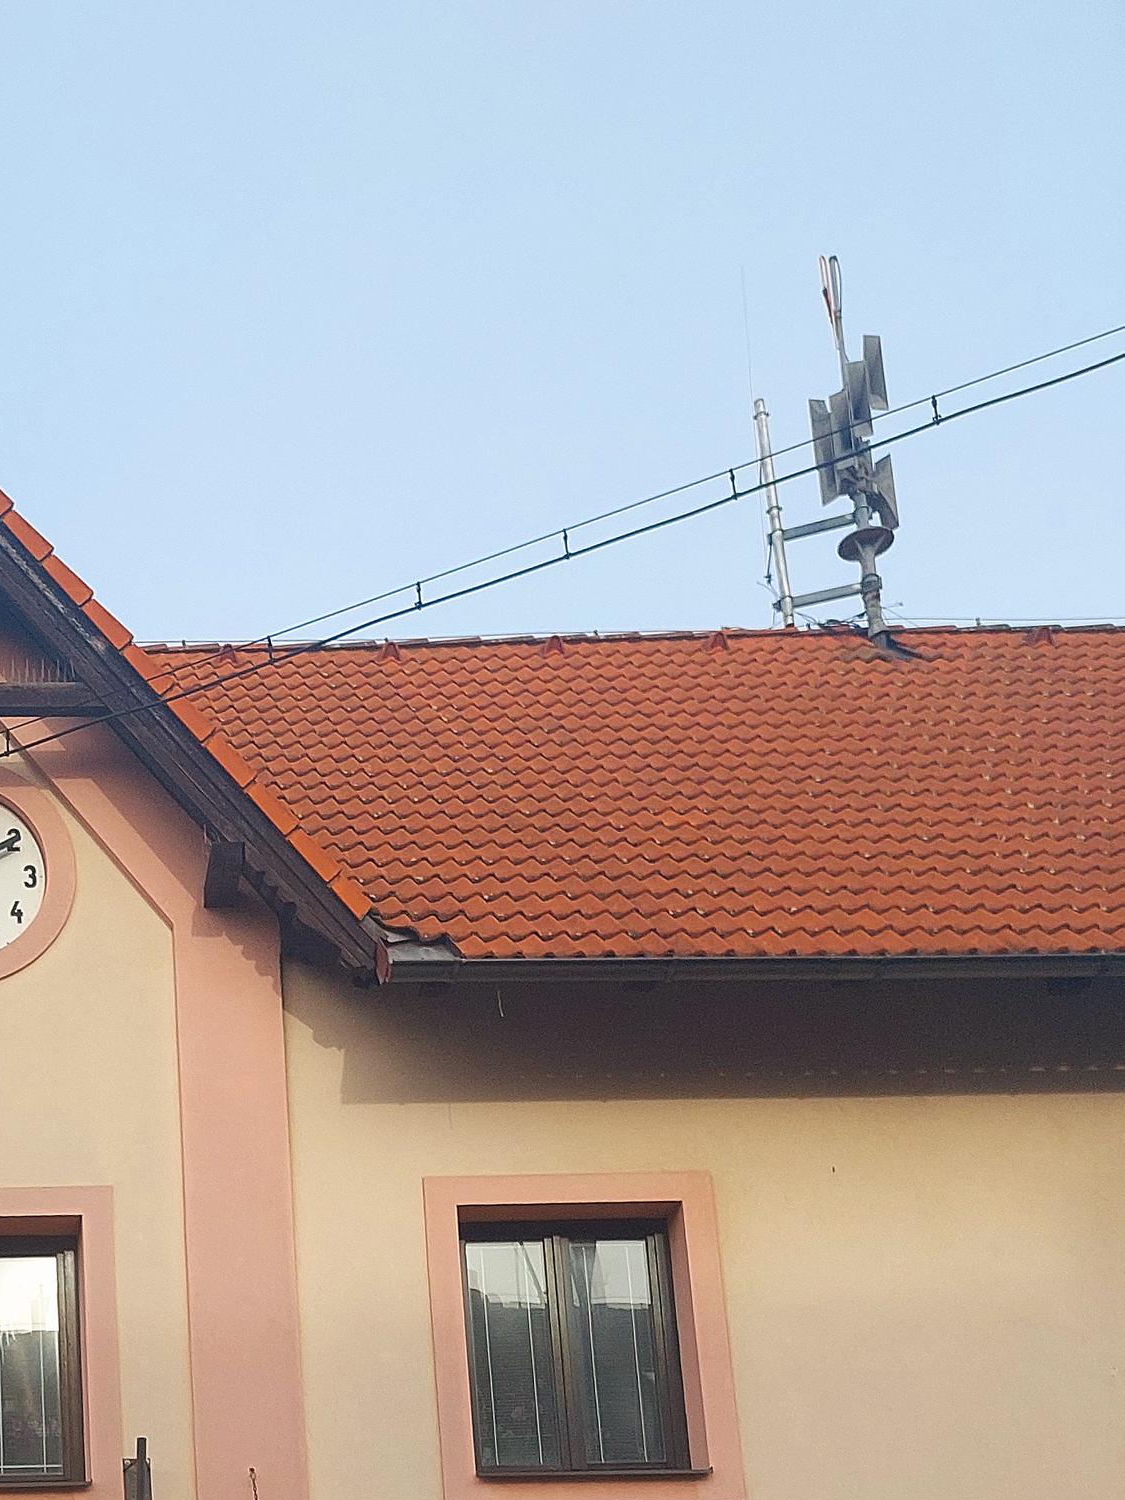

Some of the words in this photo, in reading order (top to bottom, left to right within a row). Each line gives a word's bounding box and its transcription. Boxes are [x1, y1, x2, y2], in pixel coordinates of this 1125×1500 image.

[6, 828, 22, 852] 2
[23, 865, 37, 889] 3
[10, 901, 24, 924] 4
